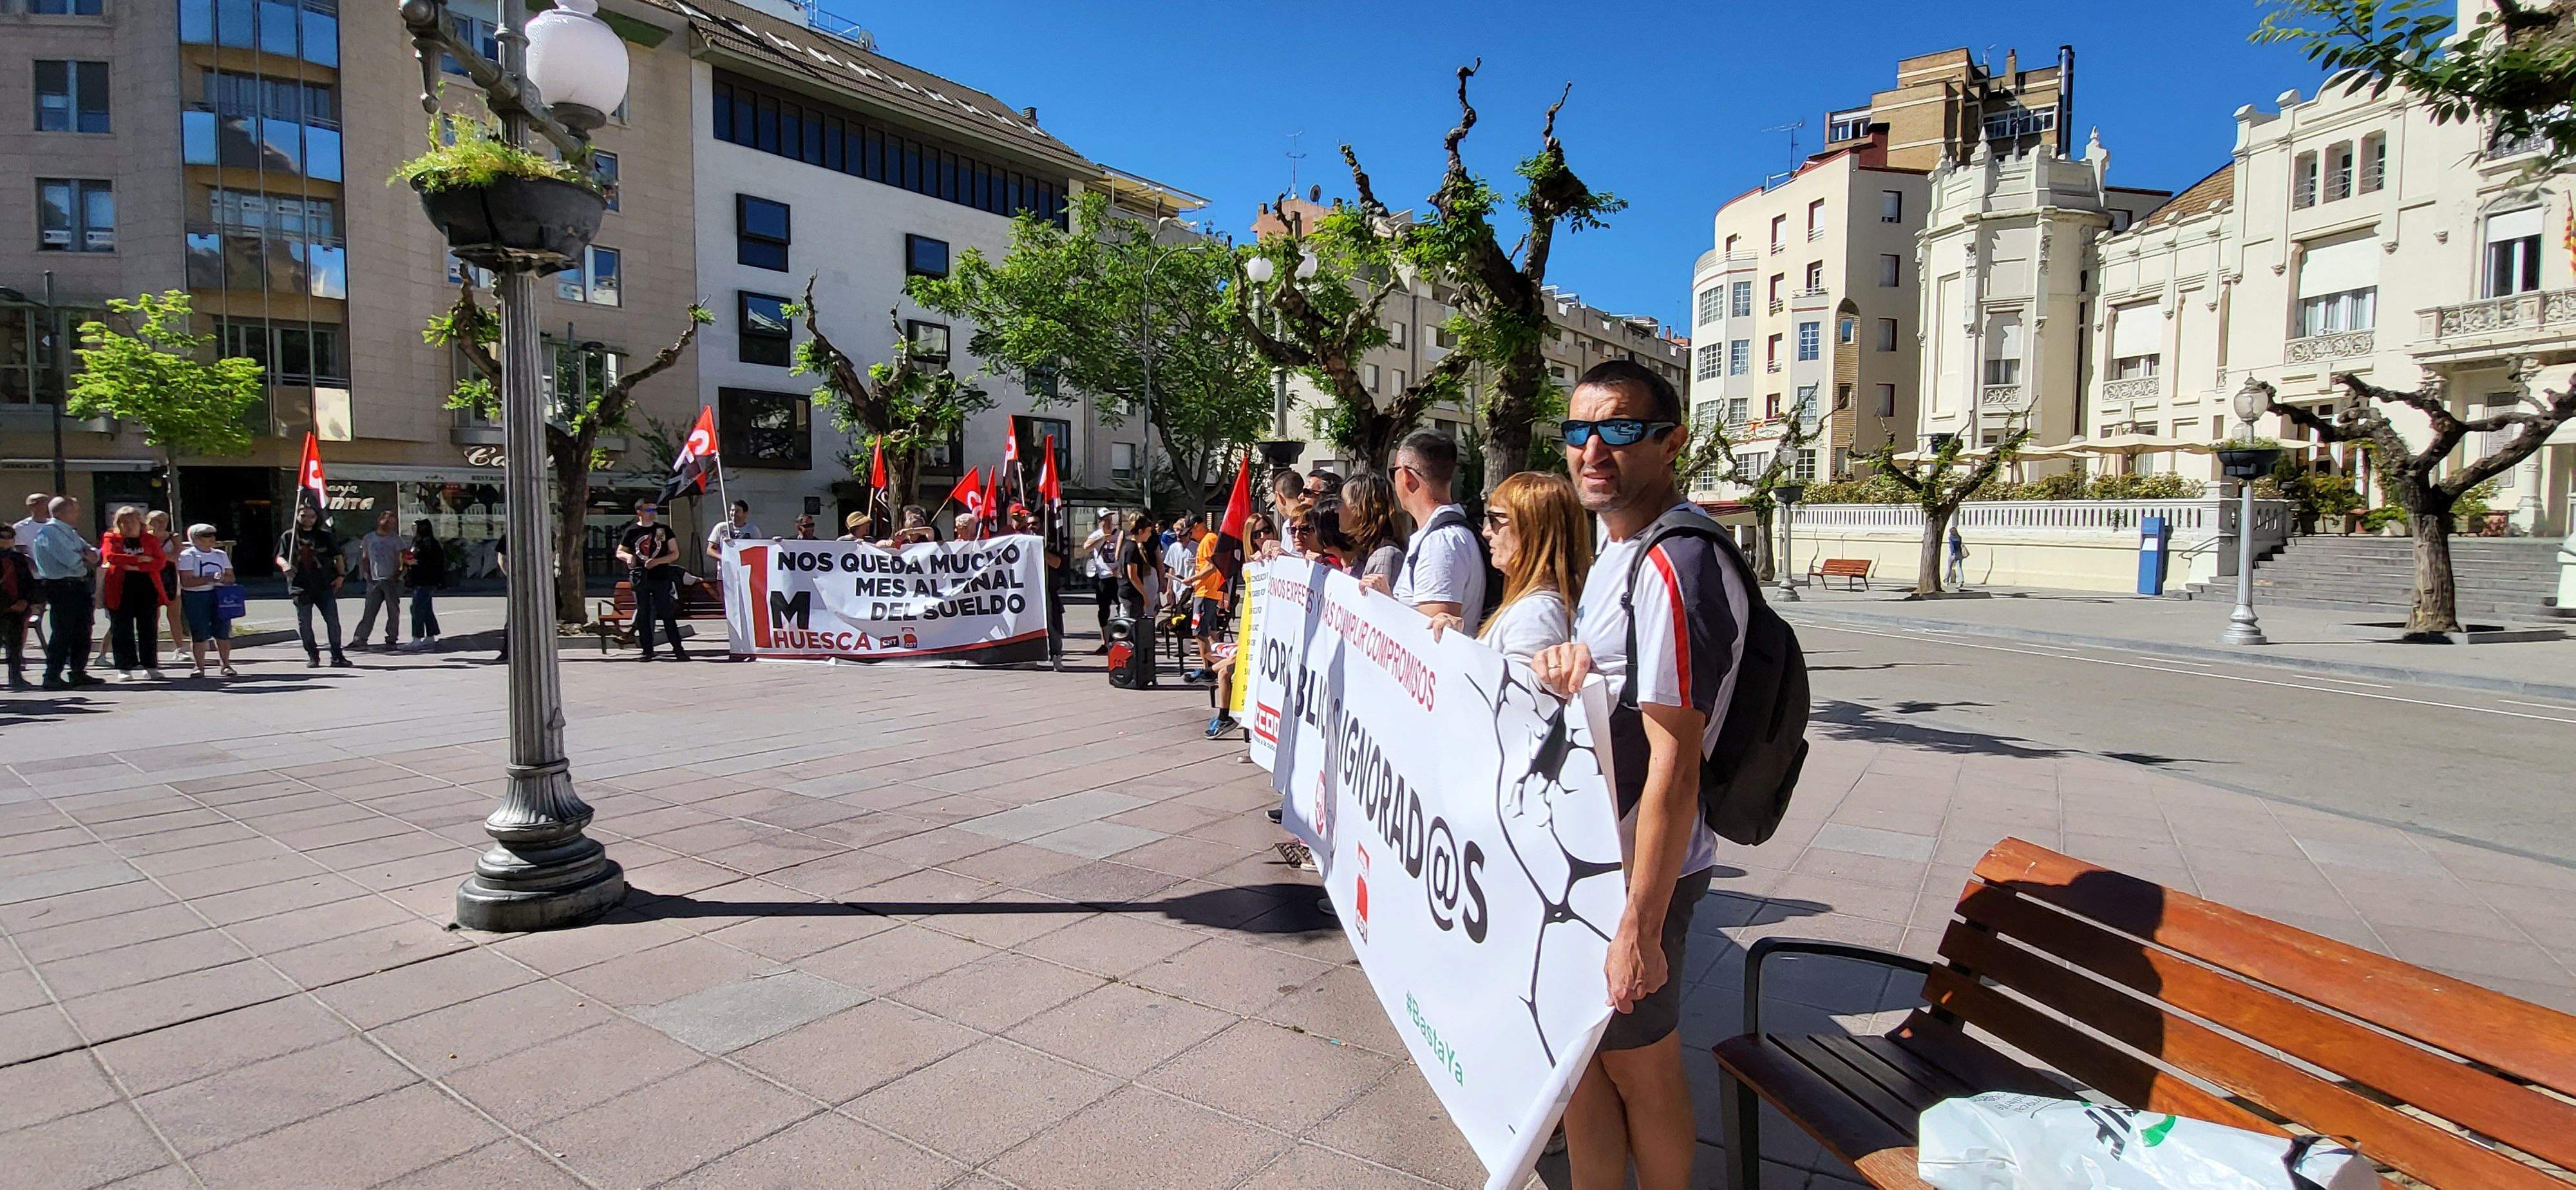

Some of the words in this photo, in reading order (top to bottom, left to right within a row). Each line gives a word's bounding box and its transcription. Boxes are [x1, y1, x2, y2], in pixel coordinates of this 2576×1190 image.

[777, 551, 834, 572] NOS
[840, 552, 923, 575] QUEDA
[931, 543, 1020, 574] MUCHO
[739, 545, 772, 648] 1
[855, 577, 907, 598] MES
[913, 577, 945, 598] AL
[952, 569, 1024, 595] FINAL
[770, 590, 811, 630] M
[871, 601, 918, 621] DEL
[923, 593, 1026, 621] SUELDO
[773, 630, 872, 651] HUESCA
[1334, 605, 1369, 653] CUMPLIR
[1366, 627, 1436, 712] COMPROMISOS
[1339, 709, 1488, 944] IGNORAD@S
[1405, 990, 1464, 1088] #BastaYa
